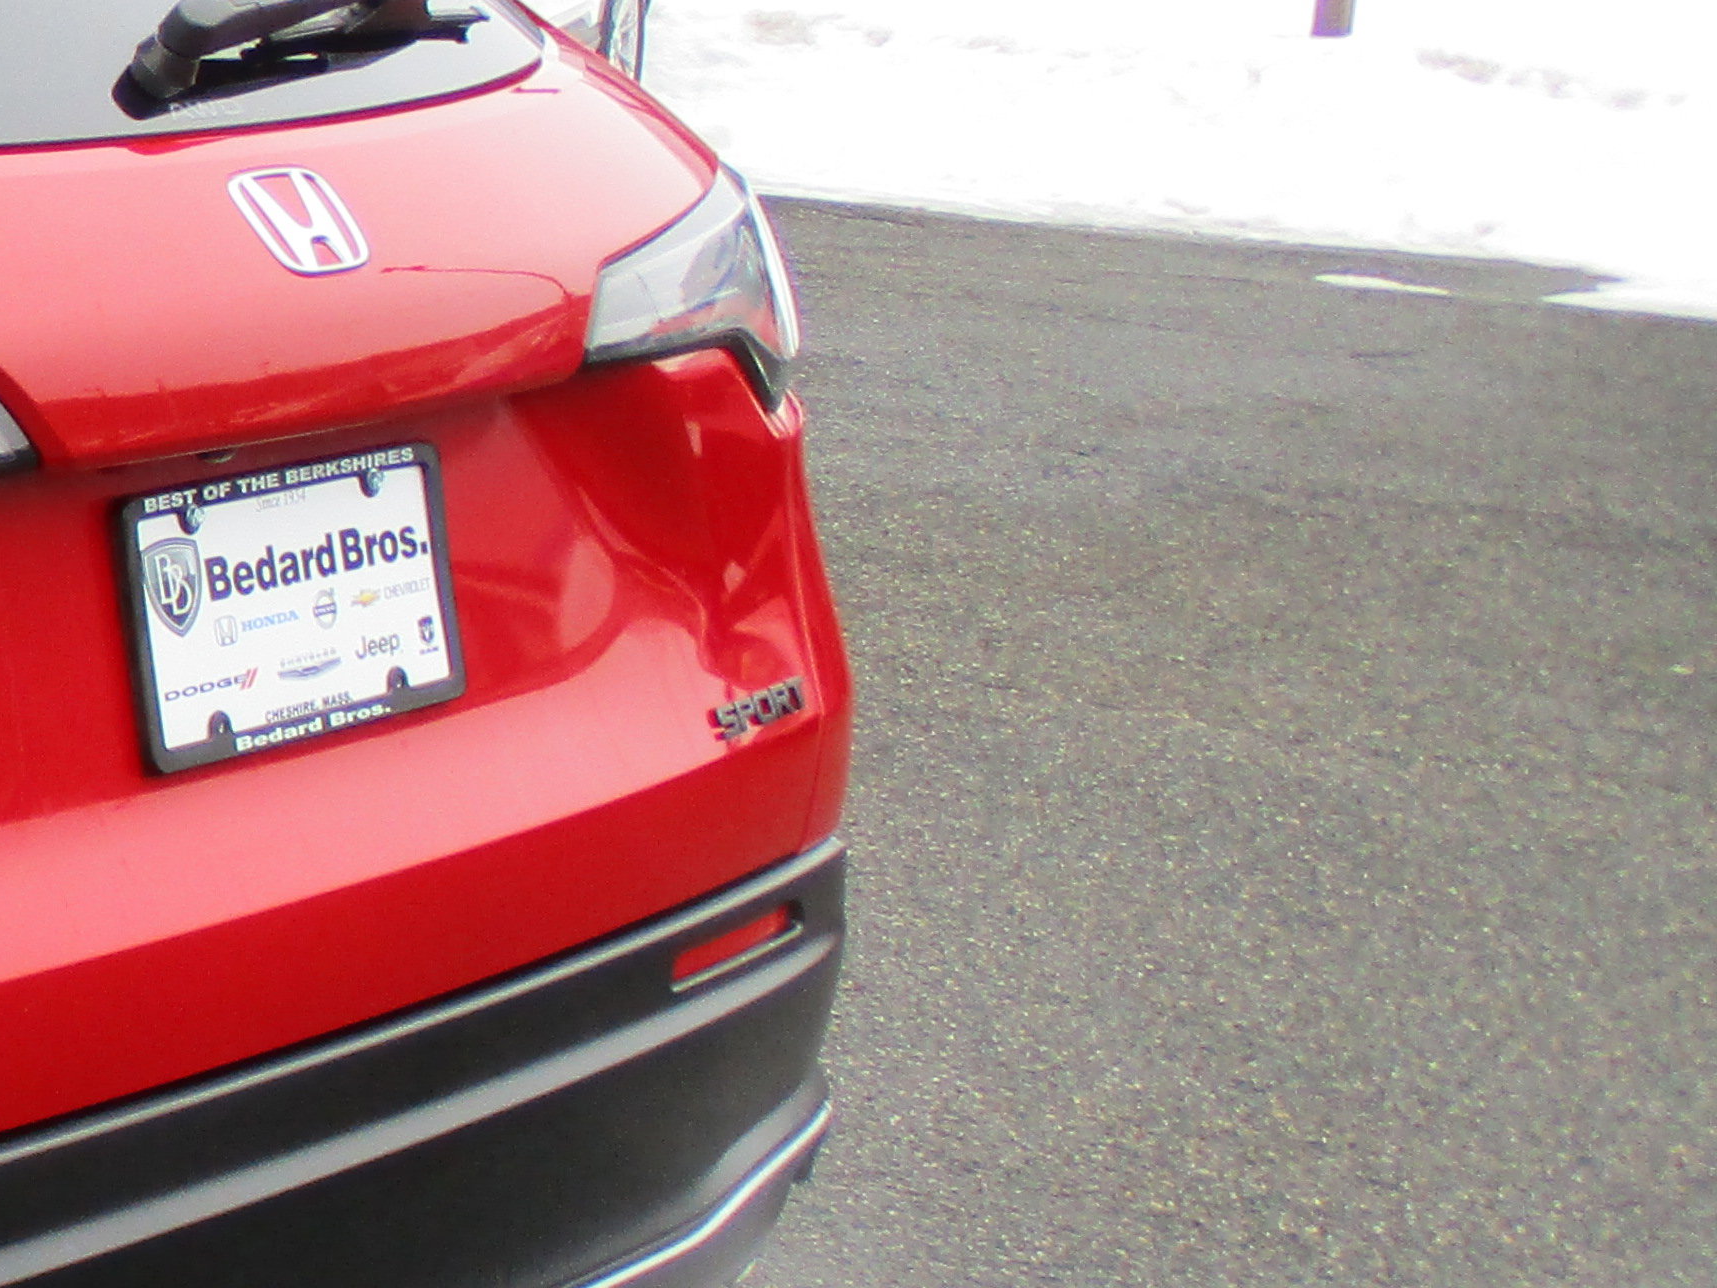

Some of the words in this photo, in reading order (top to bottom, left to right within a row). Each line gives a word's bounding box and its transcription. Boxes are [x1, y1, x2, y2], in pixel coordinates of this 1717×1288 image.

[143, 488, 197, 513] BEST
[202, 481, 232, 501] OF
[236, 472, 281, 494] THE
[284, 447, 414, 485] BERKSHIRES
[241, 609, 300, 633] HONDA
[354, 633, 401, 660] Jeep
[164, 673, 247, 701] DODGE
[234, 717, 323, 752] Bedard
[328, 703, 392, 727] Bros.
